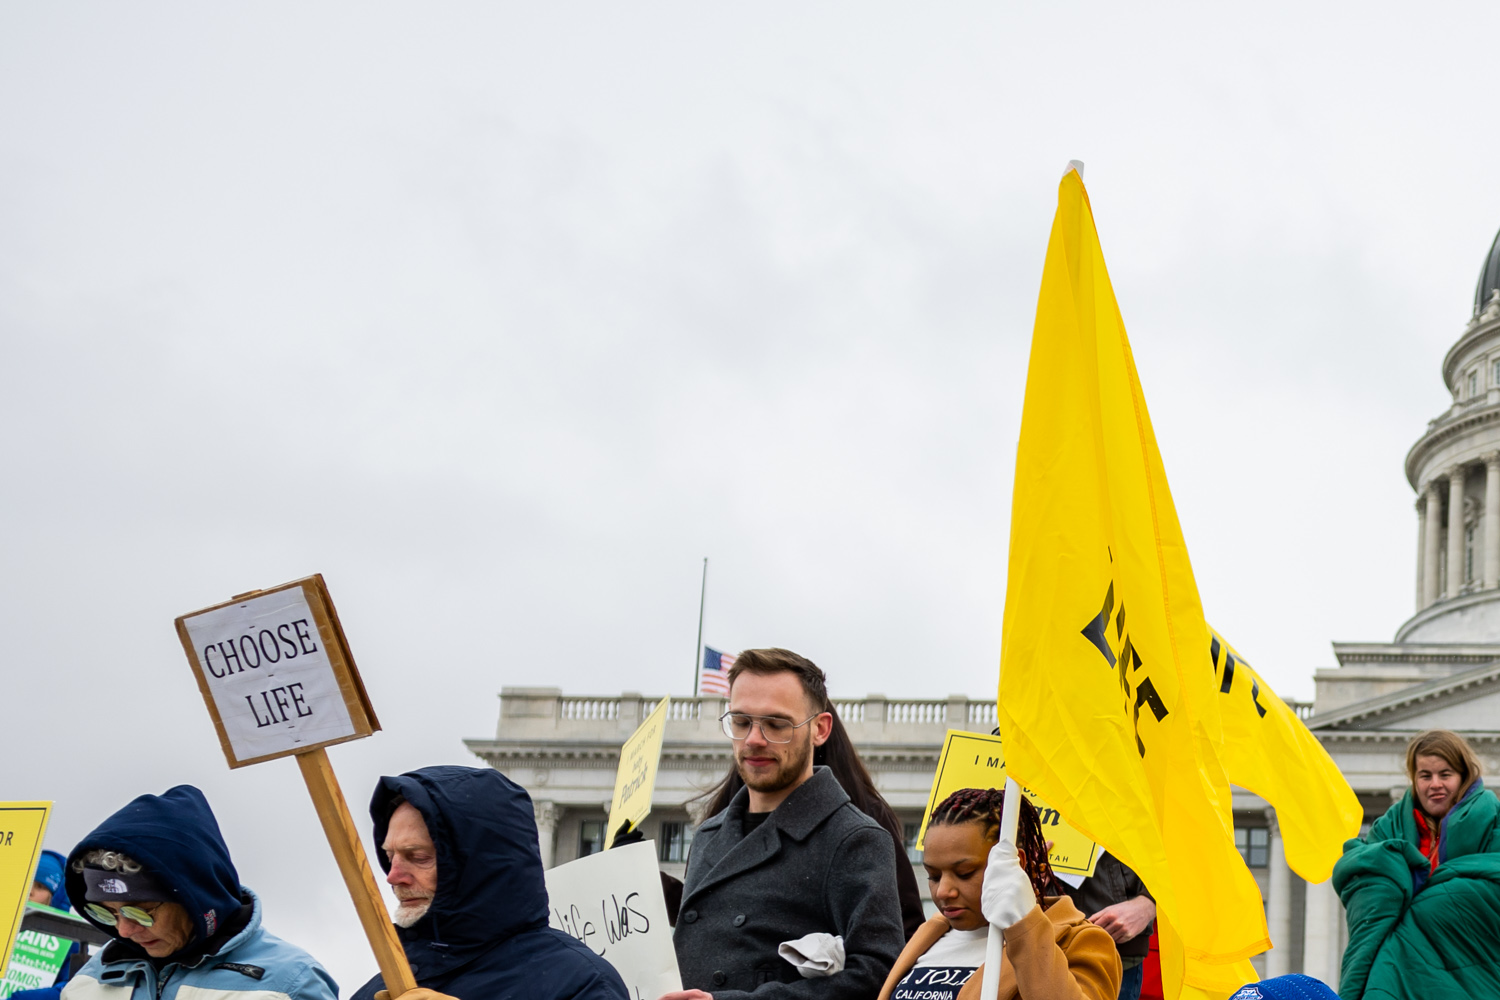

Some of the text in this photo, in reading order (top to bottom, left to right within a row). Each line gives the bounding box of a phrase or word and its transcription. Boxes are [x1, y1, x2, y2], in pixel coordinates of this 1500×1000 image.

[204, 619, 318, 678] CHOOSE
[245, 682, 313, 728] LIFE
[619, 762, 648, 810] Patrick
[1049, 854, 1069, 862] TAH
[17, 930, 59, 951] ANS
[8, 969, 42, 988] OMOS
[915, 969, 976, 986] JOLL
[895, 990, 953, 1000] CALIFORNIA
